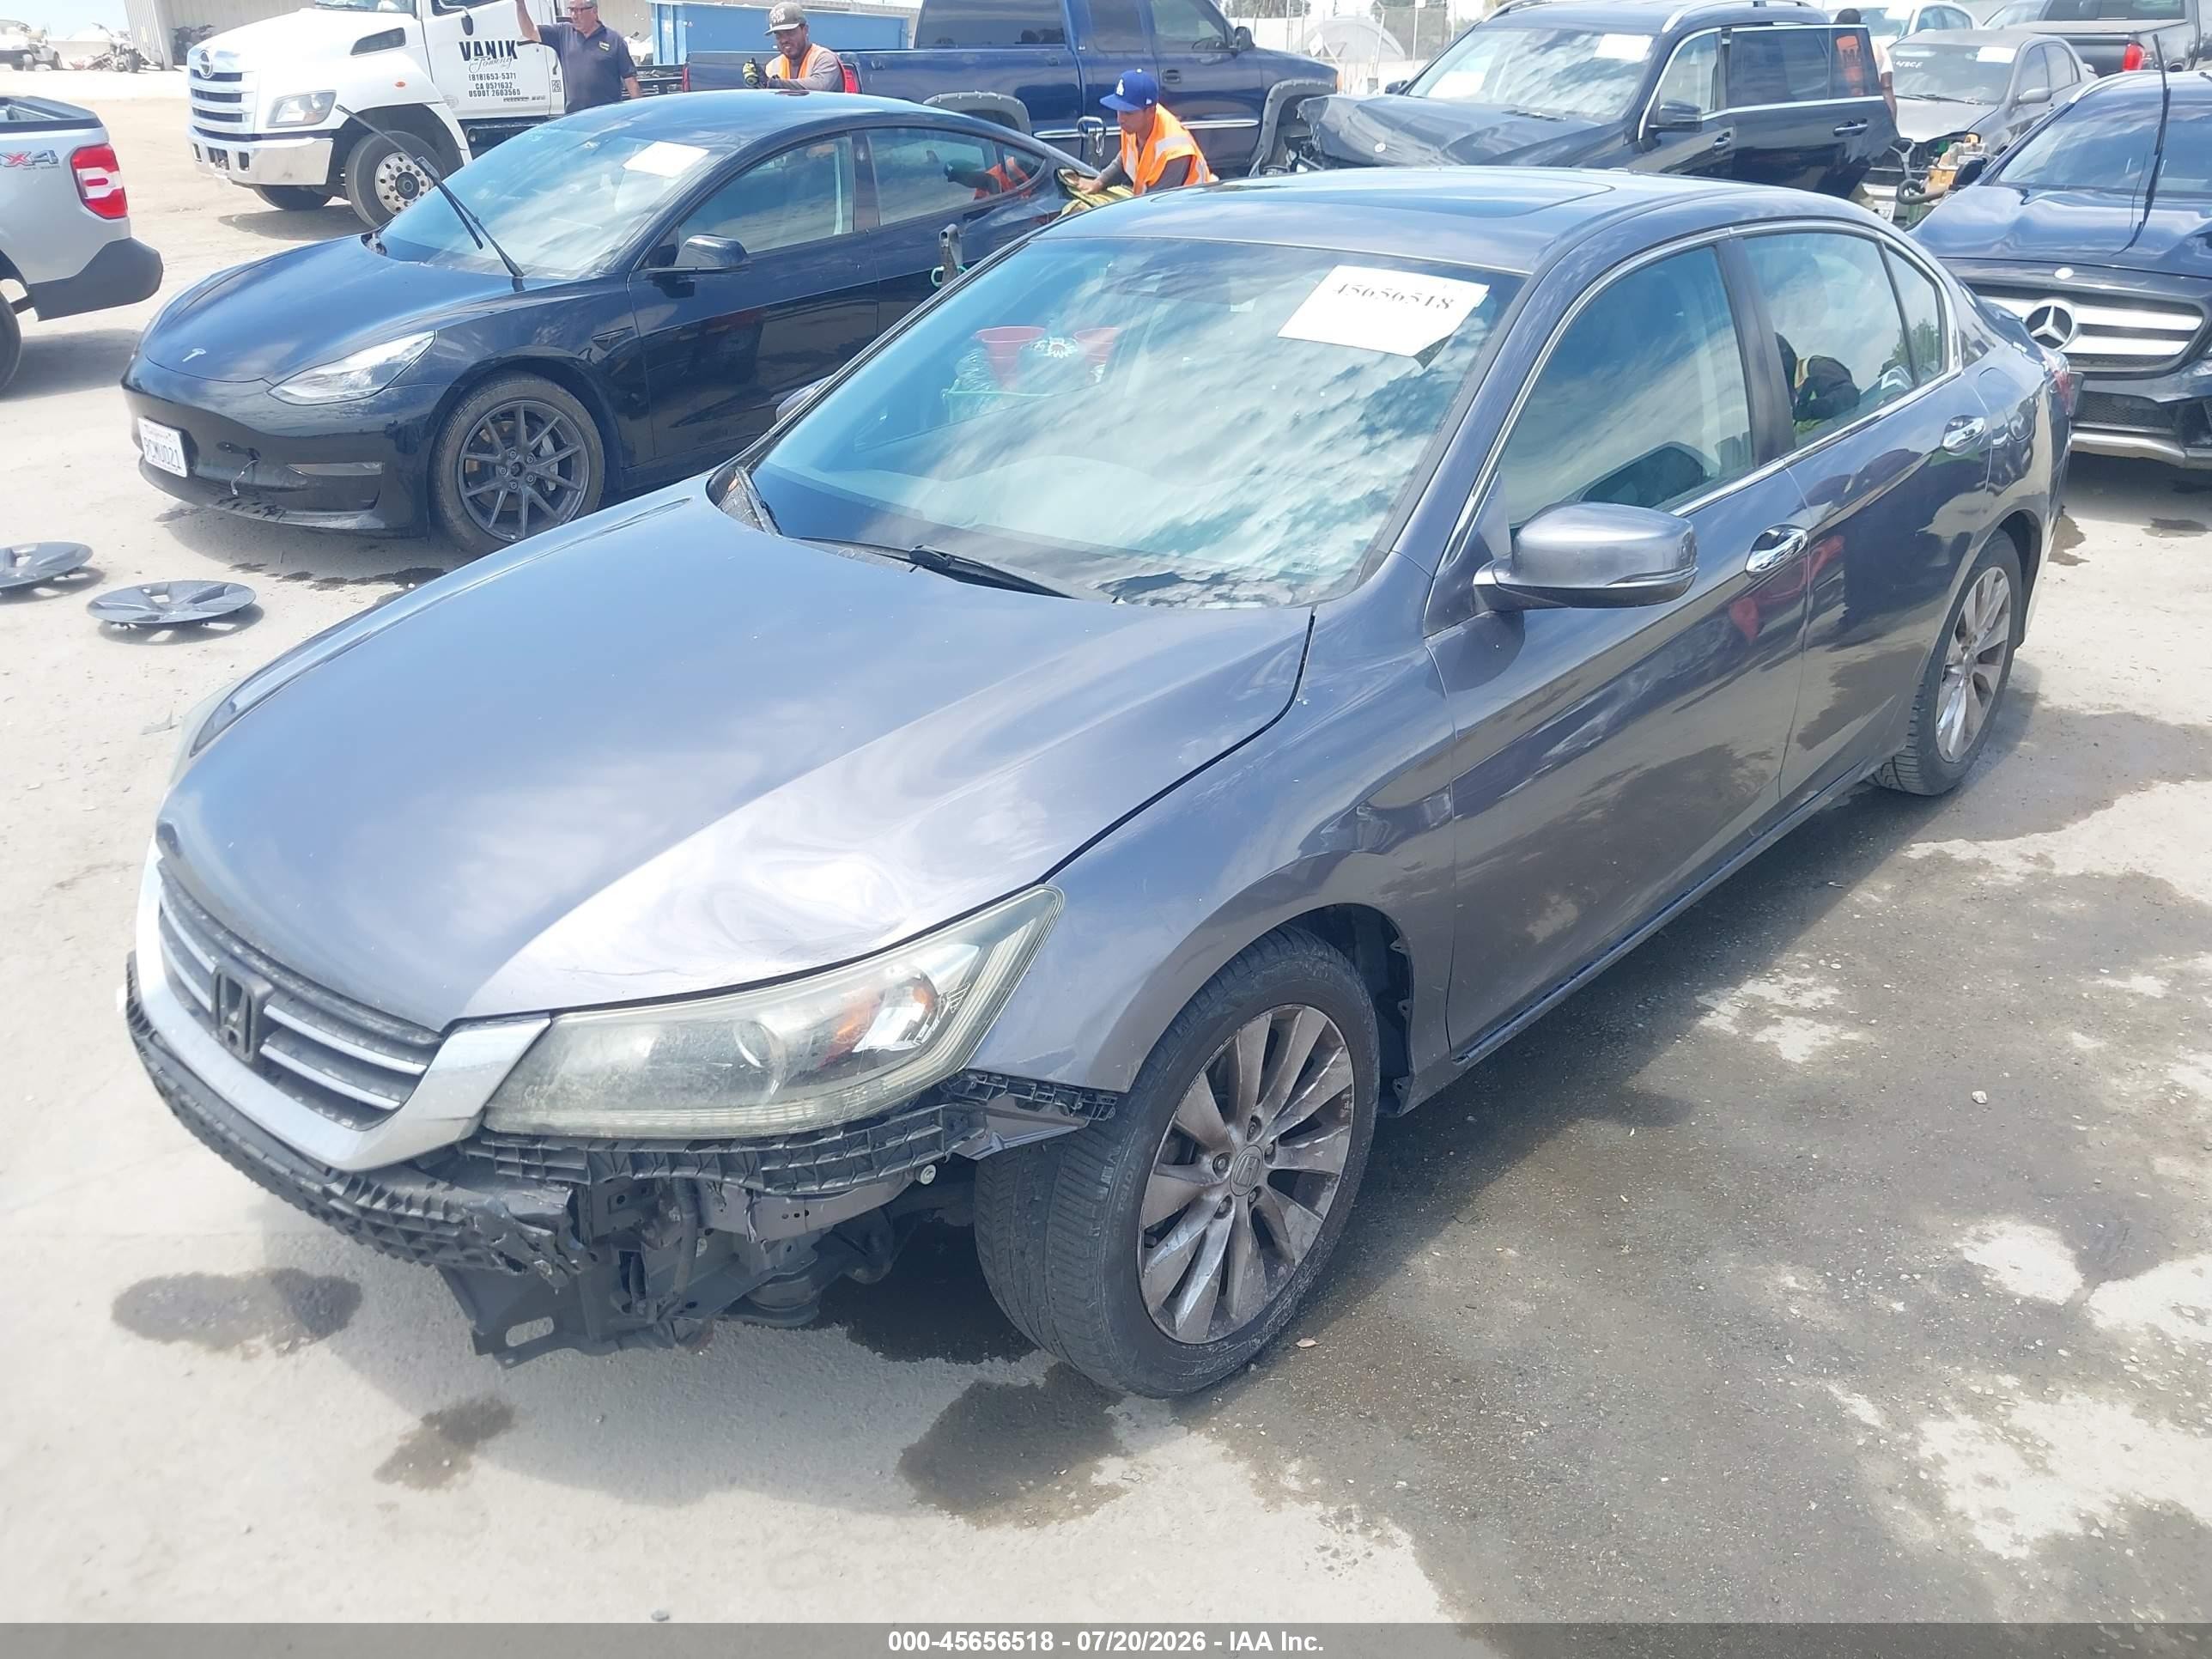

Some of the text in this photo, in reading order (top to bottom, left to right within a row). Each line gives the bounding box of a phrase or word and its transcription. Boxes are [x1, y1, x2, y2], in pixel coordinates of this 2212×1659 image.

[459, 40, 518, 62] VANIK
[468, 55, 513, 74] Towing
[468, 89, 489, 98] USDOT
